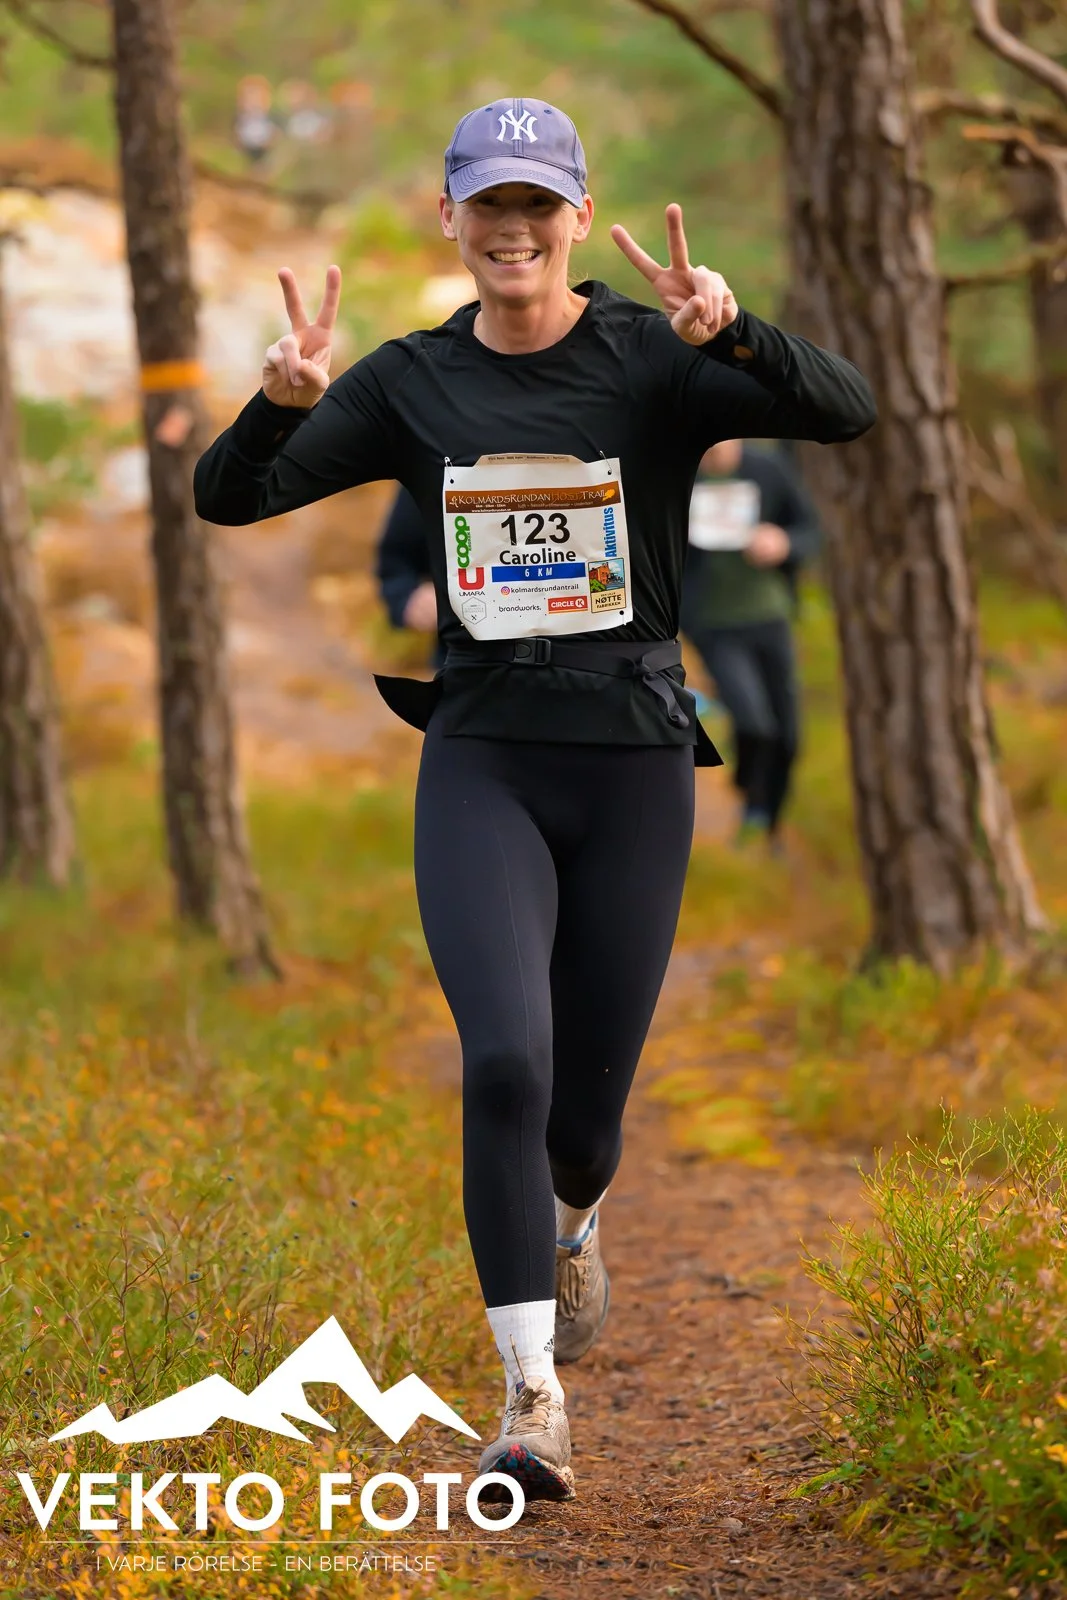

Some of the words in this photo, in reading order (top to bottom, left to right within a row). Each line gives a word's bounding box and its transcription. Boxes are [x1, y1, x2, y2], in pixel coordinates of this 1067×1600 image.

[496, 109, 538, 143] NY
[454, 515, 470, 568] coop
[500, 512, 571, 546] 123
[603, 506, 617, 558] Aktivitus
[499, 548, 577, 565] Caroline
[524, 569, 530, 577] 6
[551, 600, 574, 608] CIRCLE
